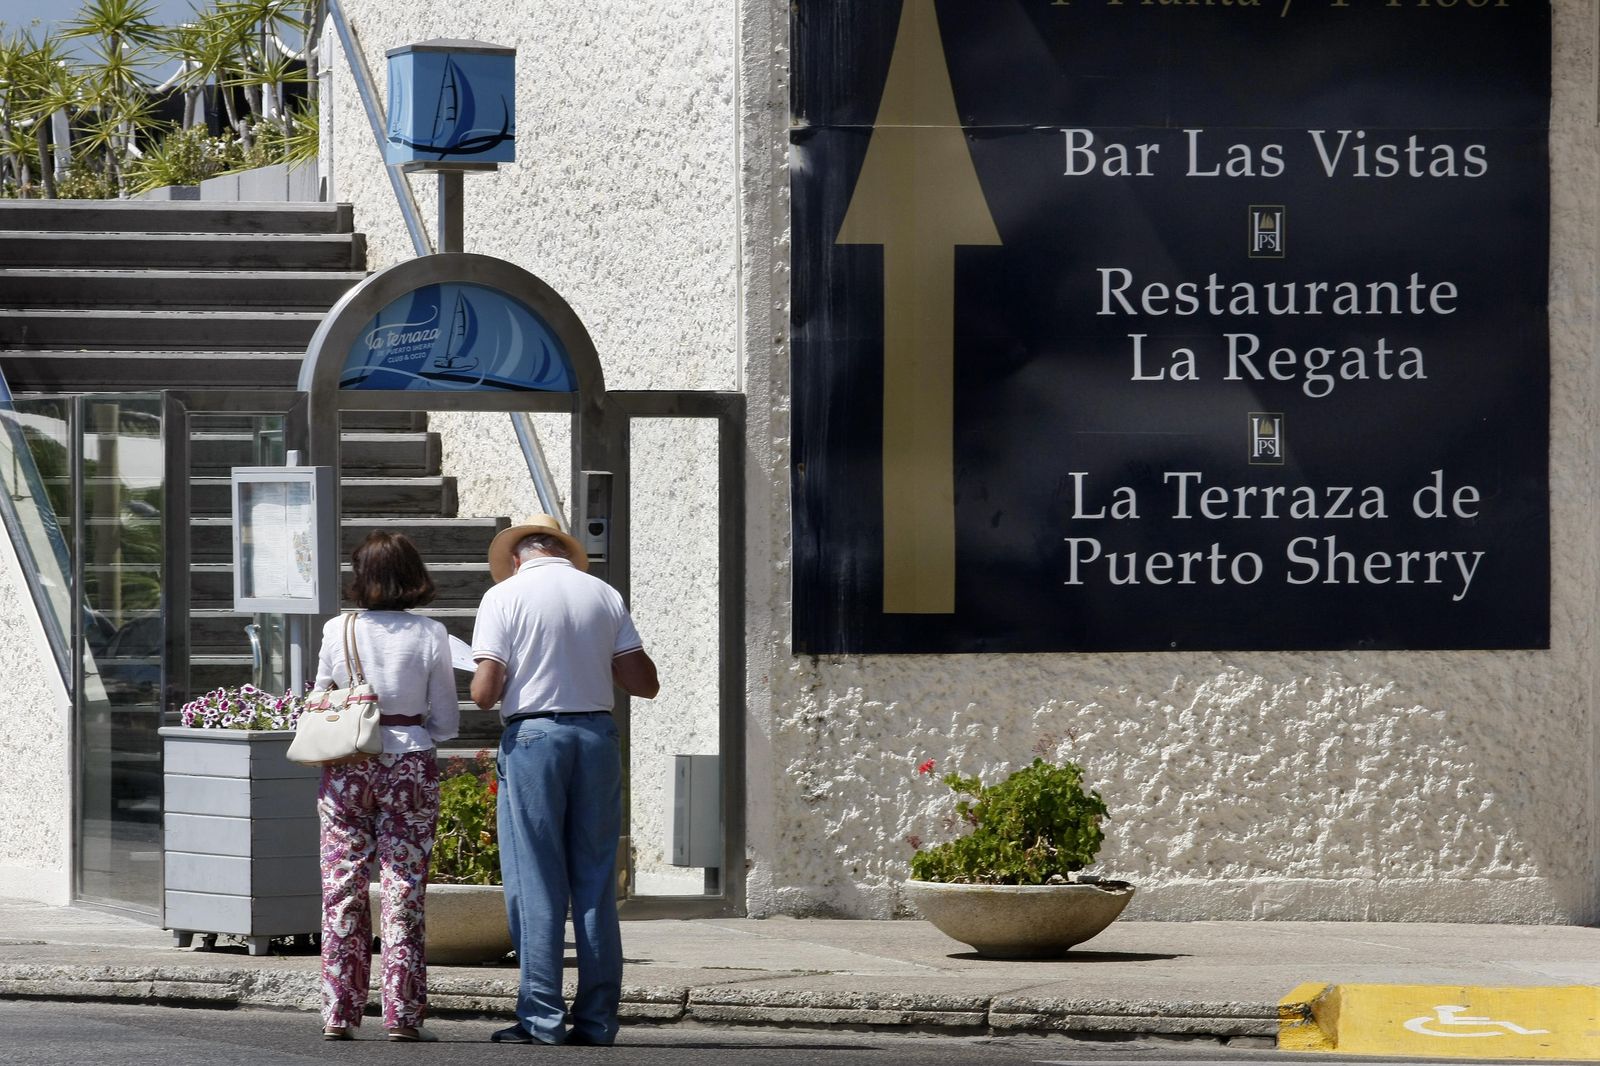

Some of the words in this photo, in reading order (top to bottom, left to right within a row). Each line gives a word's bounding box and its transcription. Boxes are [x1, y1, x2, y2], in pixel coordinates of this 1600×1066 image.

[1061, 128, 1160, 177] Bar
[1183, 129, 1285, 178] Las
[1307, 130, 1489, 178] Vistas
[1096, 267, 1459, 316] Restaurante
[387, 328, 441, 347] terraza
[1128, 333, 1200, 381] La
[1223, 333, 1428, 398] Regata
[1068, 471, 1140, 520] La
[1163, 471, 1389, 520] Terraza
[1412, 469, 1481, 520] de
[1064, 537, 1263, 586] Puerto
[1286, 535, 1486, 603] Sherry
